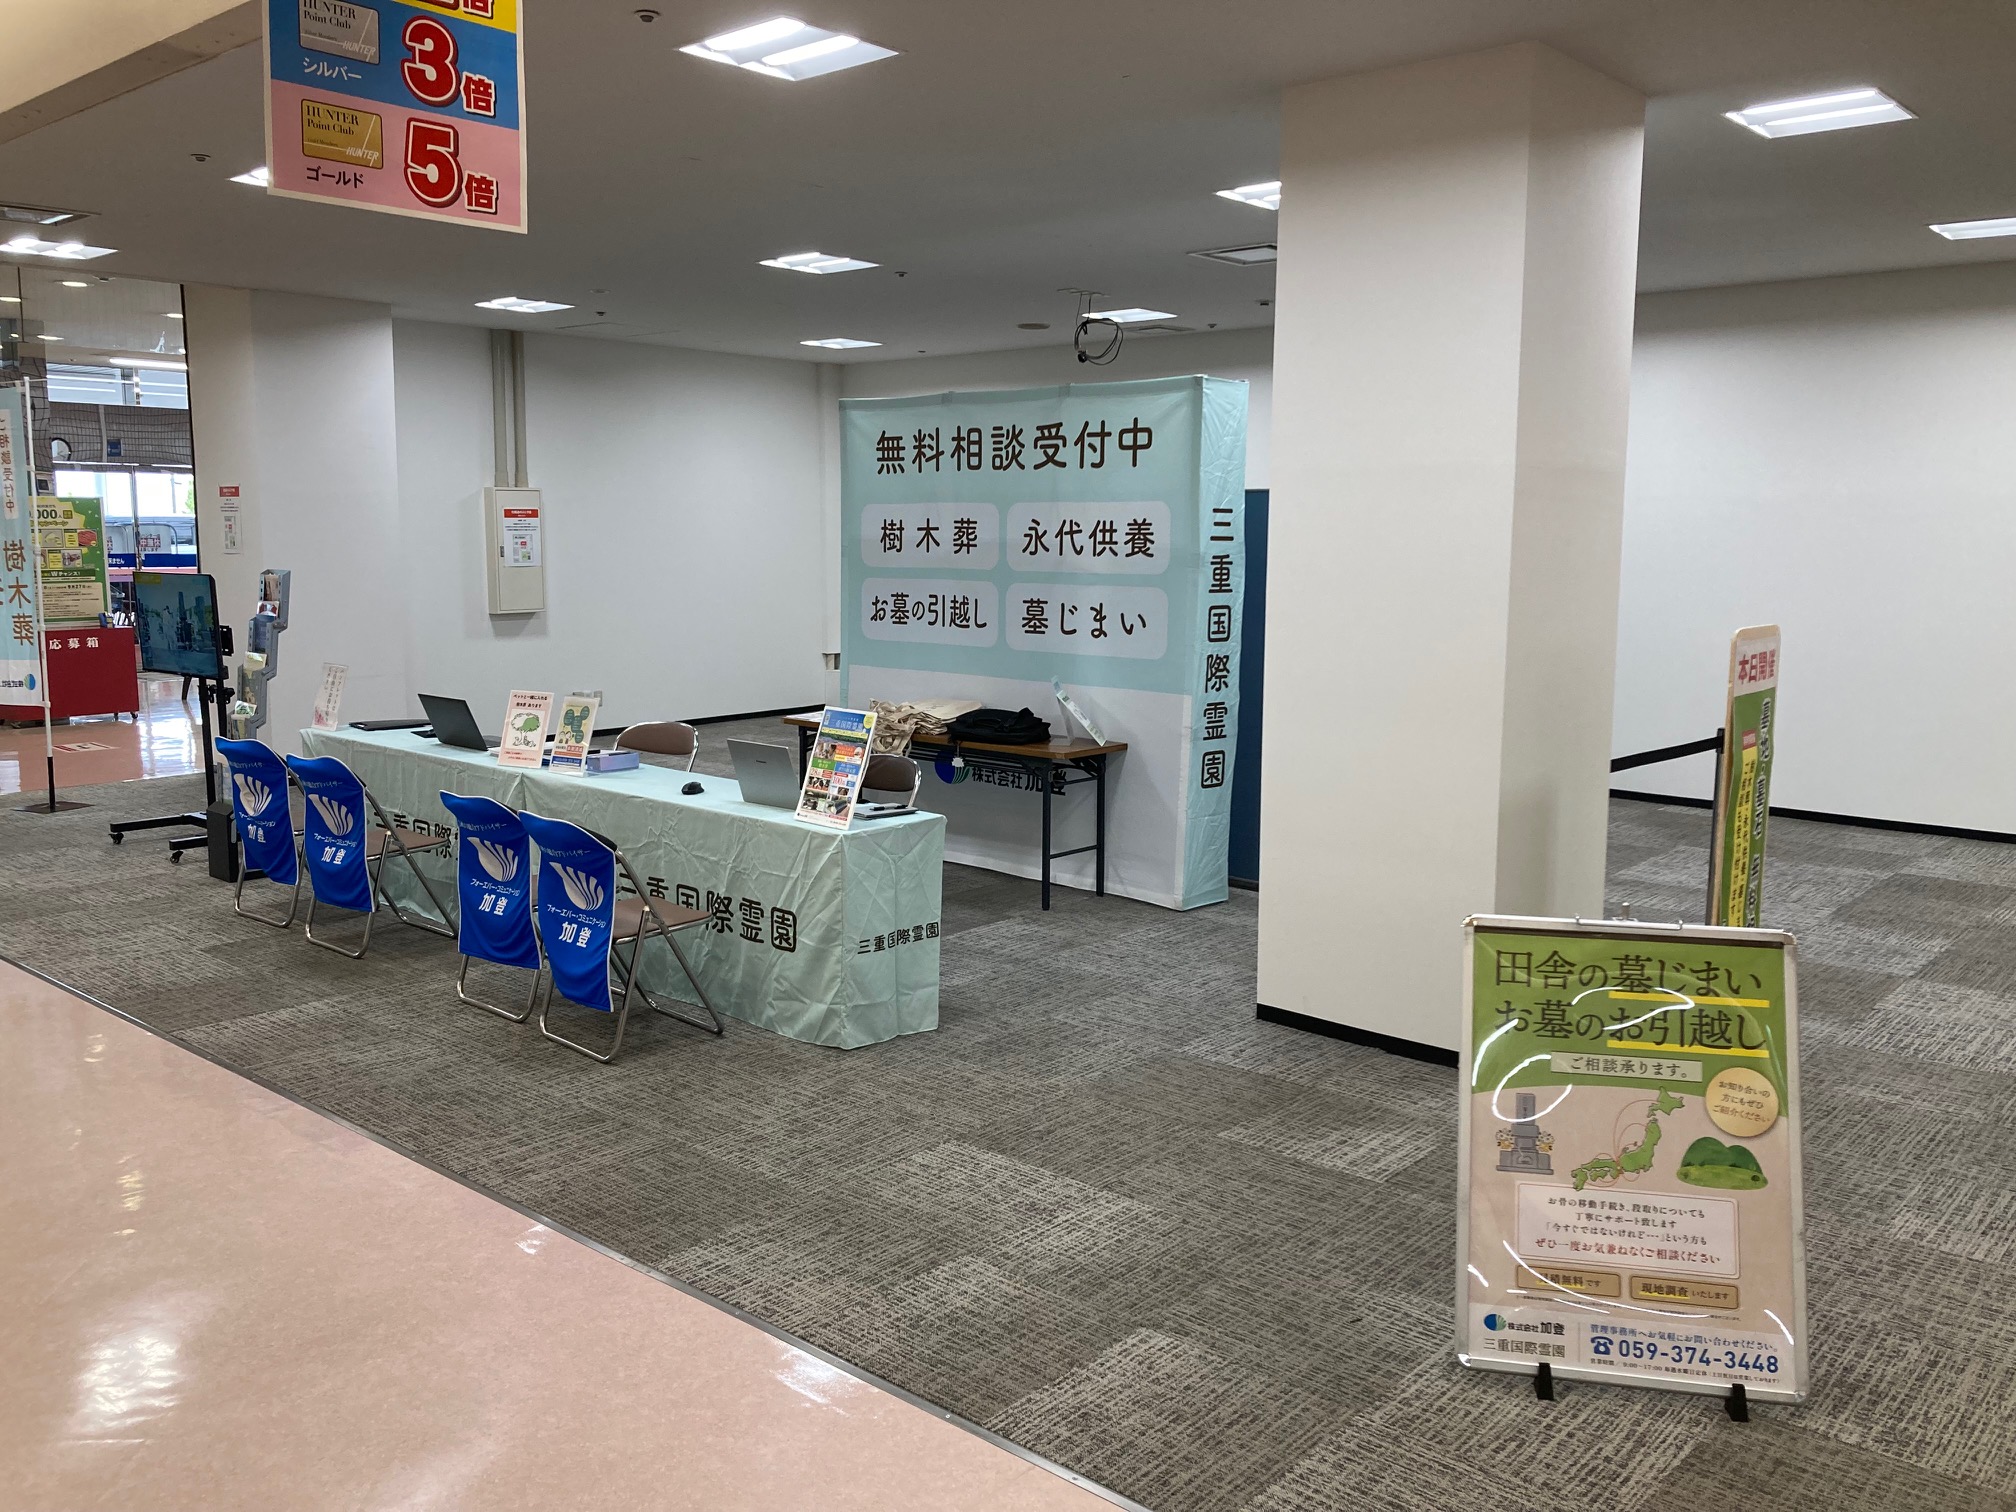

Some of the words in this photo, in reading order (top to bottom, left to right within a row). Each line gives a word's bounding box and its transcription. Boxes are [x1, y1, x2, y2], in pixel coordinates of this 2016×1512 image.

[303, 0, 356, 19] HUNTER
[304, 10, 327, 24] Point
[329, 16, 351, 29] Club
[342, 40, 376, 56] HUNTER
[302, 57, 362, 81] シルバー
[401, 15, 496, 118] 3倍
[306, 105, 359, 126] HUNTER
[307, 118, 332, 132] Point
[332, 124, 355, 136] Club
[346, 147, 379, 161] HUNTER
[404, 117, 498, 215] 5倍
[306, 167, 364, 188] ゴールド
[875, 416, 1153, 476] 無料相談受付中
[880, 517, 978, 555] 樹木葬
[1021, 517, 1154, 559] 永代供養
[870, 592, 987, 631] お墓の引越し
[1021, 598, 1147, 640] 墓じまい
[49, 637, 99, 650] 応募箱
[1200, 508, 1234, 789] 三重国際霊園
[321, 845, 347, 865] 加登
[478, 892, 509, 916] 加登
[558, 921, 592, 948] 加登
[857, 922, 940, 954] 三重国際霊園
[1495, 949, 1762, 996] 田舎の墓じまい
[1494, 999, 1767, 1050] お墓のお引越し
[1570, 1056, 1688, 1079] ご相談承ります。
[1483, 1337, 1566, 1358] 三重国際霊園
[1618, 1339, 1779, 1374] 059-374-3448
